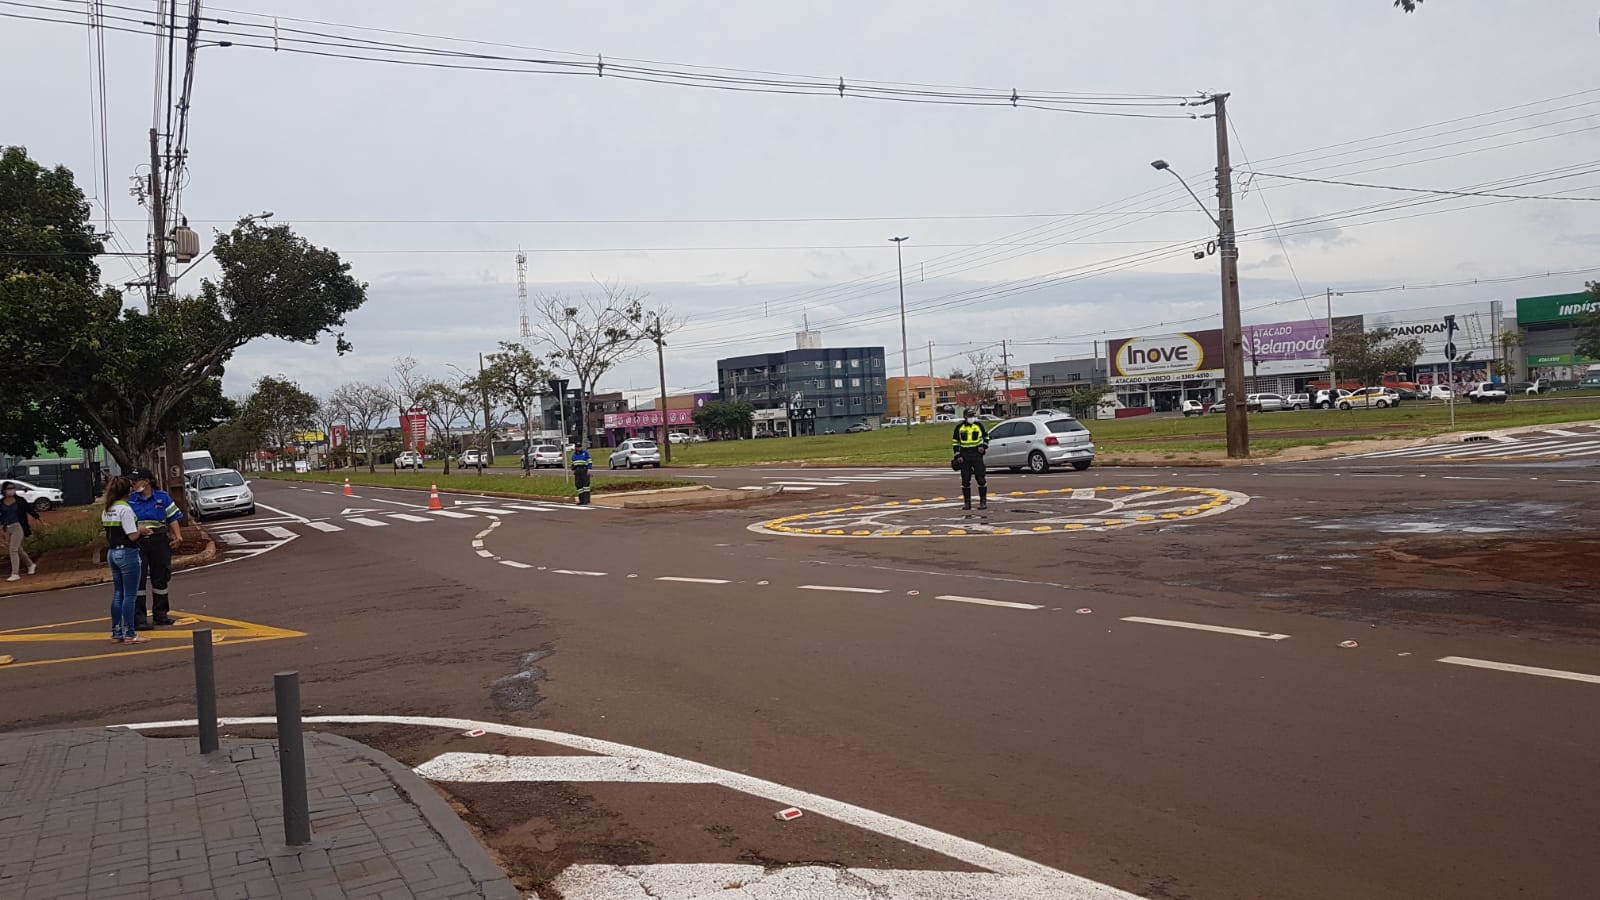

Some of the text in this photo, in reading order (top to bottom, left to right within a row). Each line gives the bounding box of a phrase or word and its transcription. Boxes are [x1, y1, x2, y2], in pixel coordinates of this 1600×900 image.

[1253, 326, 1292, 338] ATACADO
[1391, 321, 1460, 336] PANORAMA
[1252, 335, 1325, 355] Belamoda
